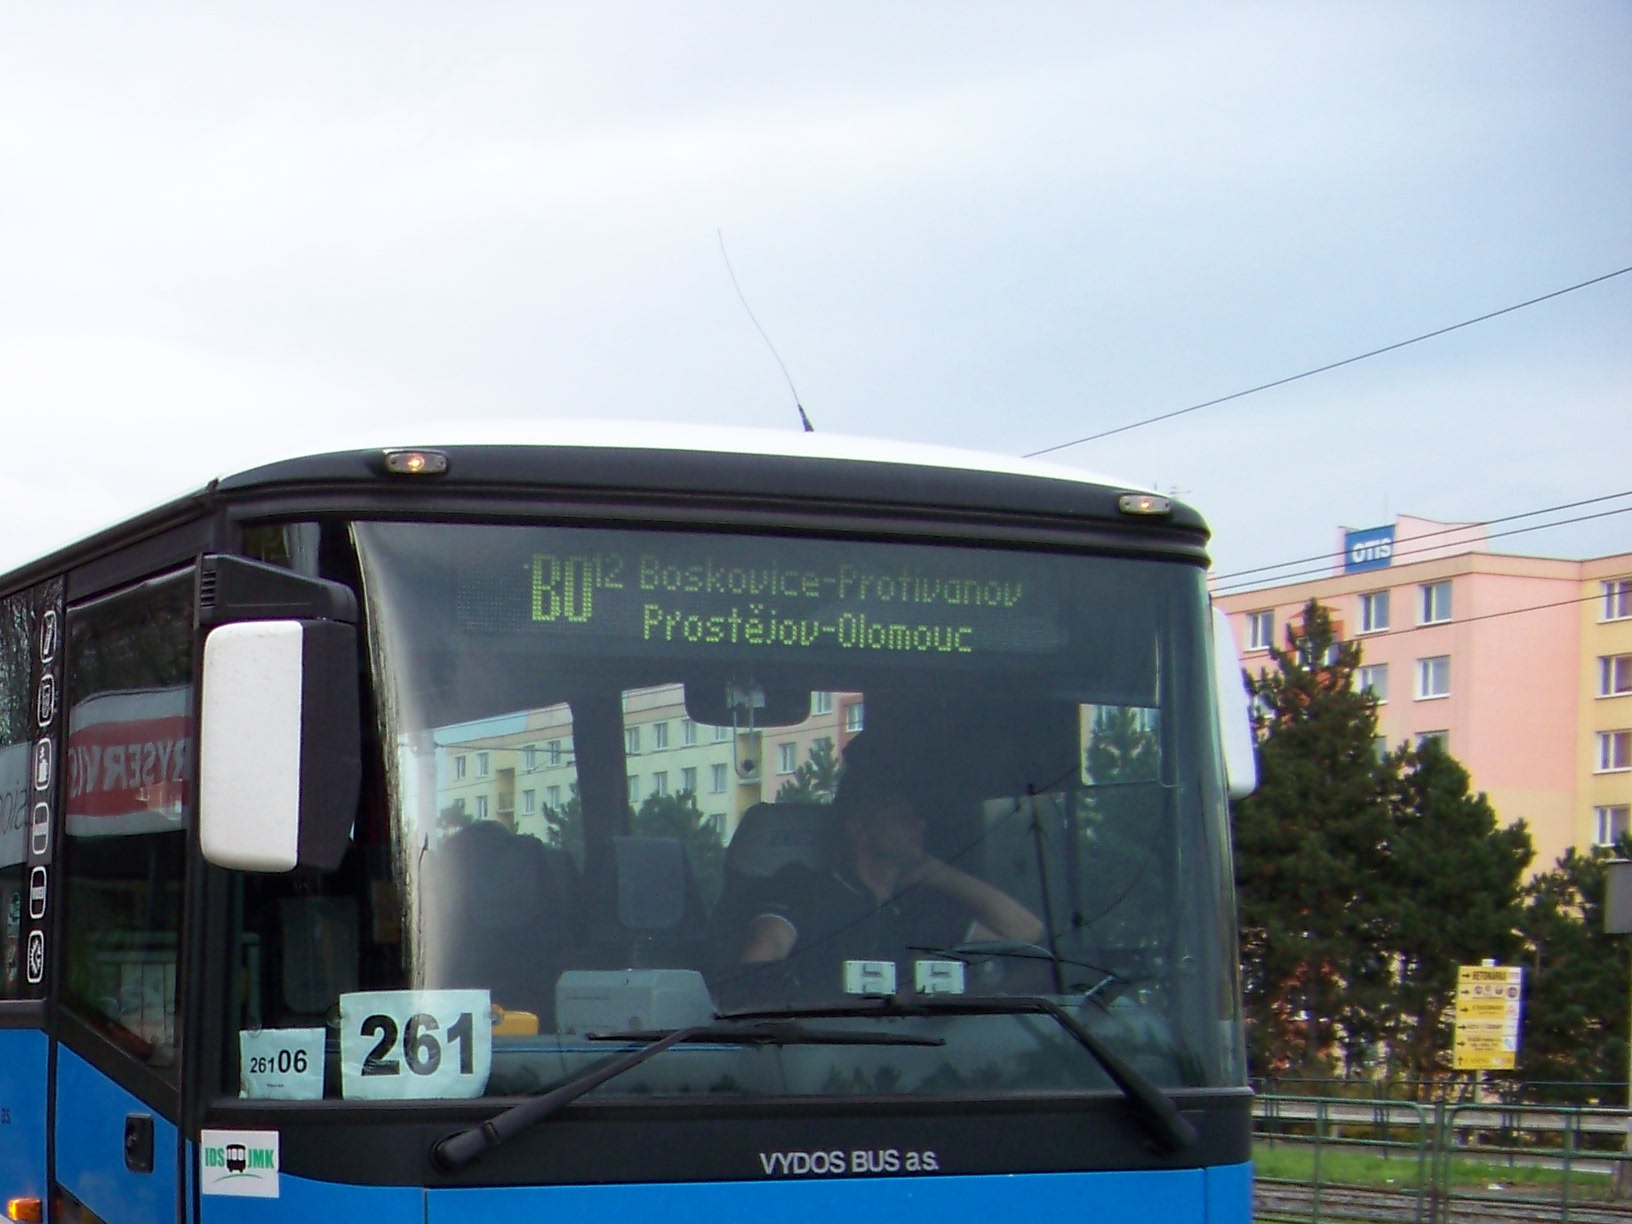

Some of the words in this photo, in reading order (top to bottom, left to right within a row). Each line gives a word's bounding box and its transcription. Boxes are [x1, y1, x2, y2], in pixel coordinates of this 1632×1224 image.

[1352, 538, 1392, 564] OTIS
[360, 1012, 474, 1077] 261
[205, 1147, 225, 1168] IDS
[247, 1147, 275, 1169] JMK
[759, 1150, 846, 1175] VYDOS
[851, 1149, 900, 1173] BUS
